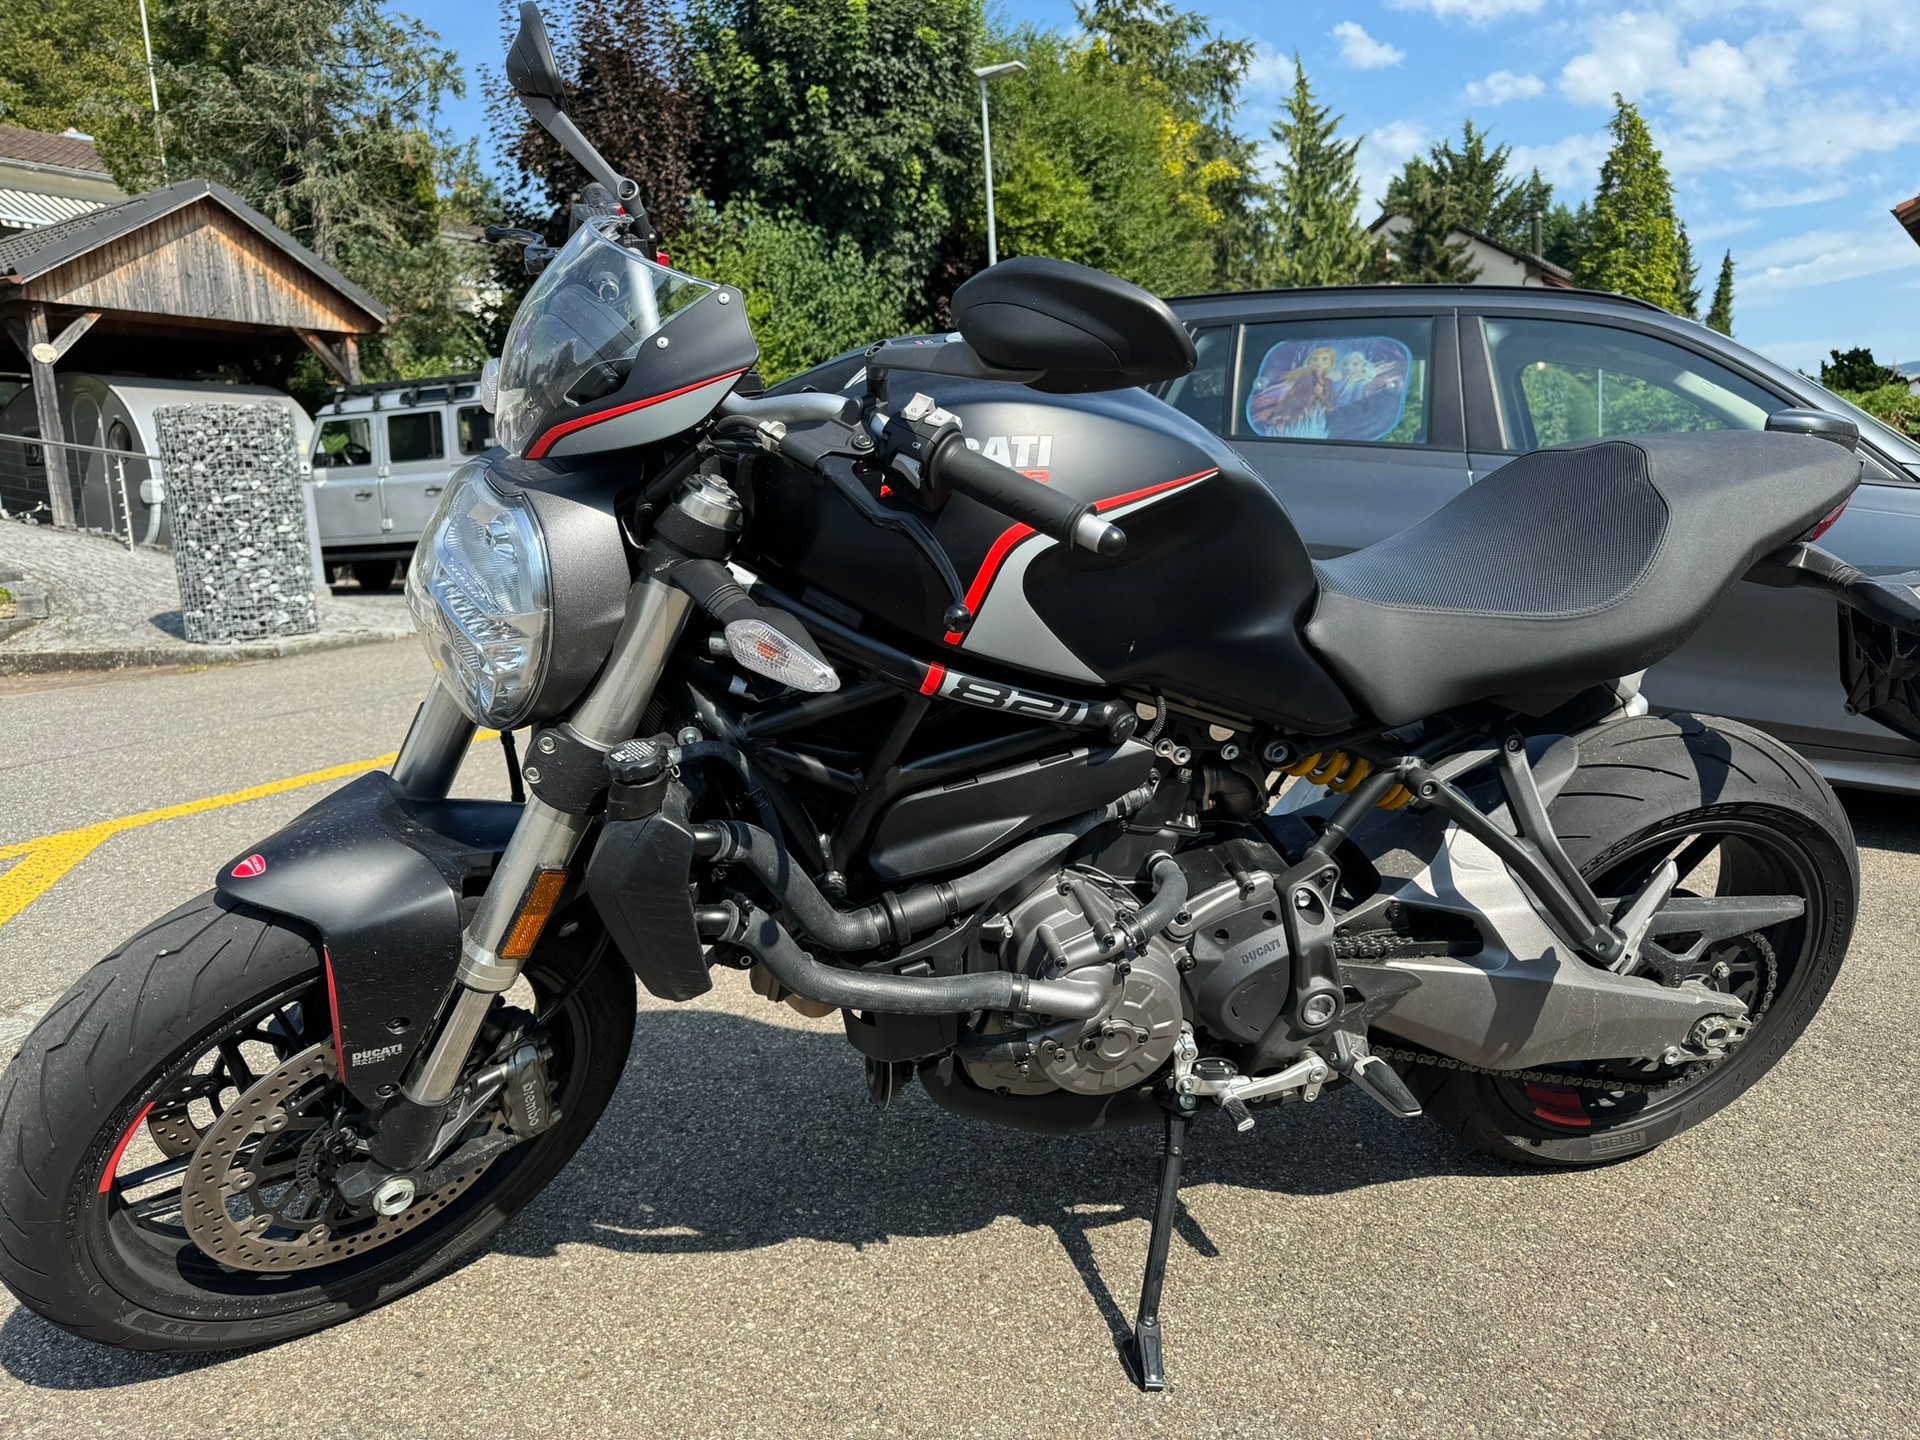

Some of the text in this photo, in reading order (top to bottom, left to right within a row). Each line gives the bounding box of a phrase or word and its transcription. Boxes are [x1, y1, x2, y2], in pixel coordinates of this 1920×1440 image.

[948, 675, 1082, 724] 821
[1239, 938, 1281, 966] DUCATI
[351, 1043, 403, 1060] DUCATI
[522, 1080, 542, 1127] brembo
